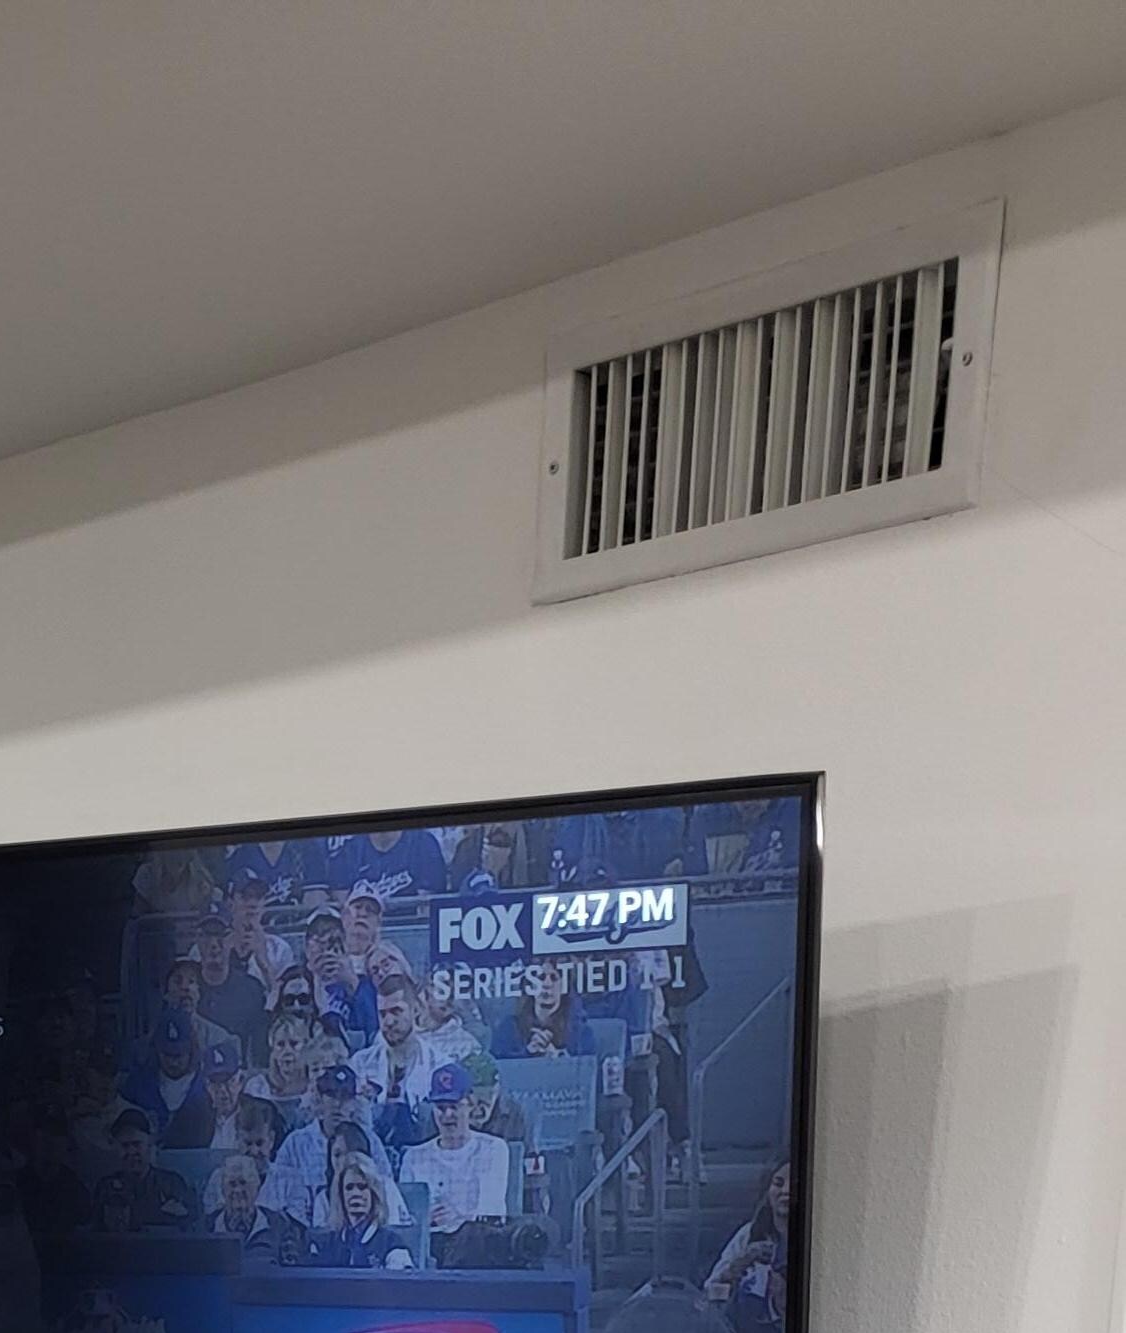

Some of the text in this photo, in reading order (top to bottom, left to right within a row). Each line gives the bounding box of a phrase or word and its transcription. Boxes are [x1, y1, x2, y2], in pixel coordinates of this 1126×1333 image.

[438, 903, 524, 953] FOX
[537, 887, 674, 929] 7:47 PM
[432, 956, 686, 1000] SERIES TIED 11
